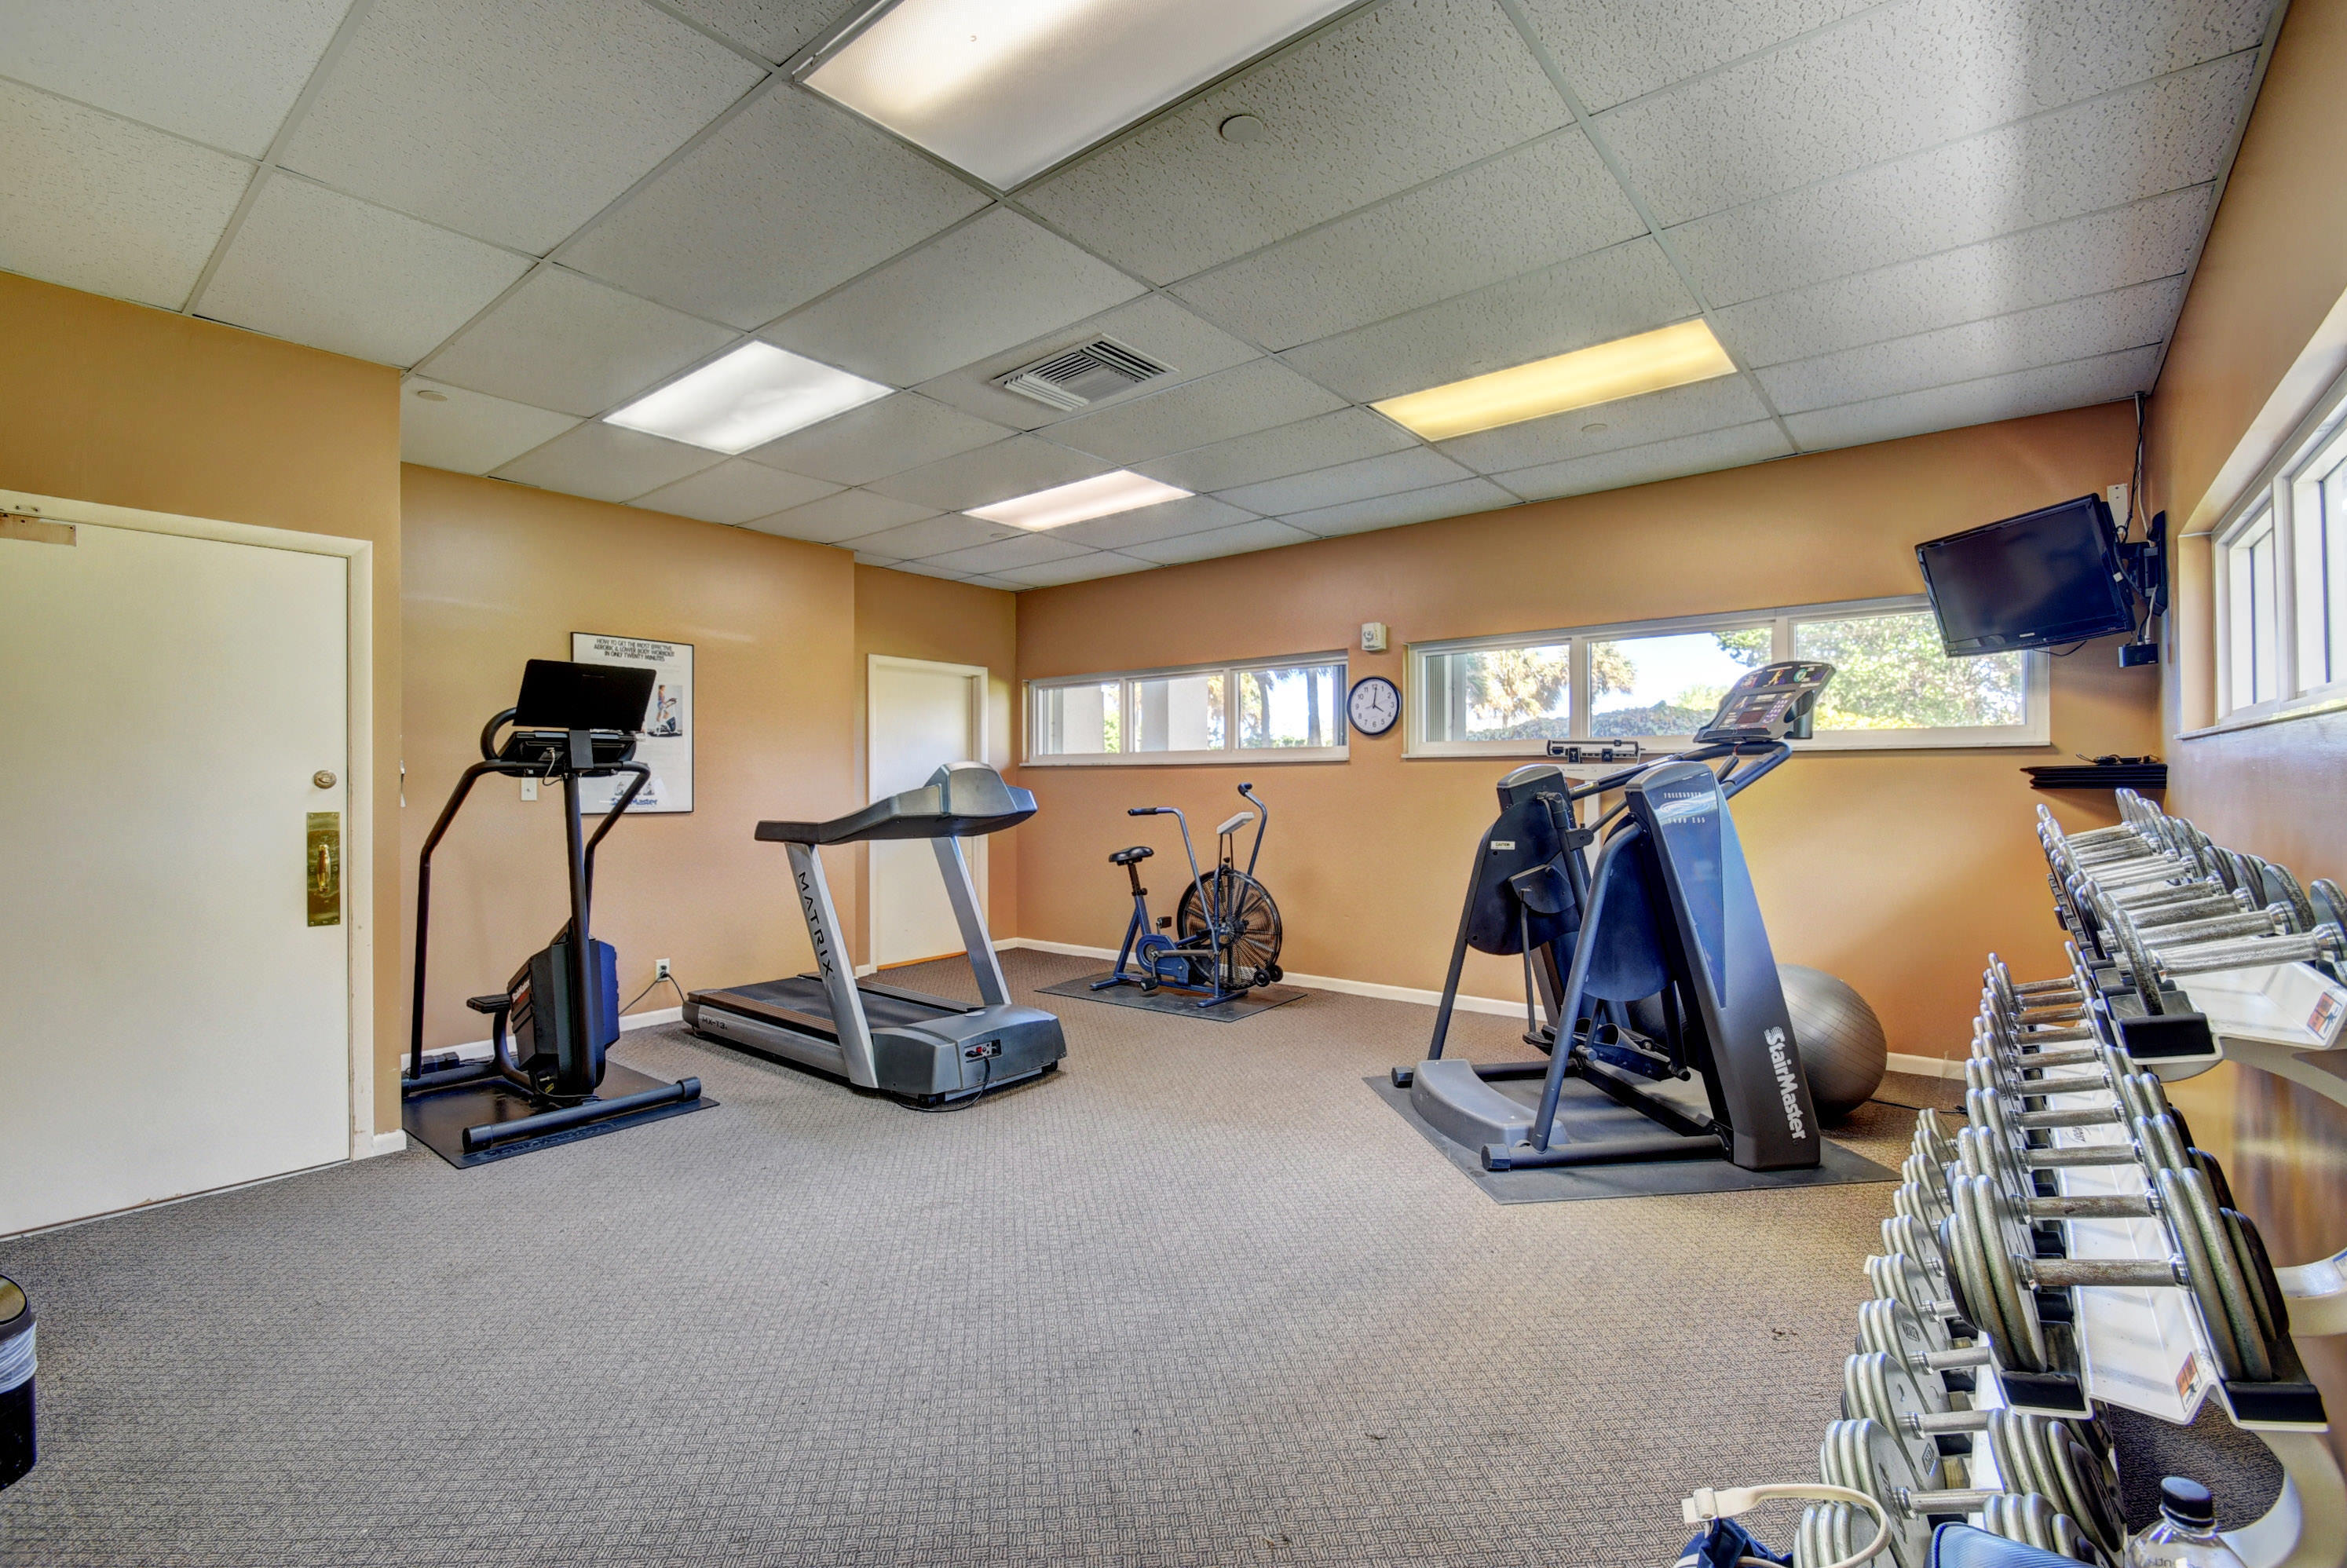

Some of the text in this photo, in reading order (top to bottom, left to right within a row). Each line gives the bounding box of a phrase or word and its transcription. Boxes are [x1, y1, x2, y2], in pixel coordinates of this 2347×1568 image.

[623, 652, 644, 660] TWENTY
[799, 872, 834, 977] MATRIX
[1764, 1026, 1807, 1140] StairMaster
